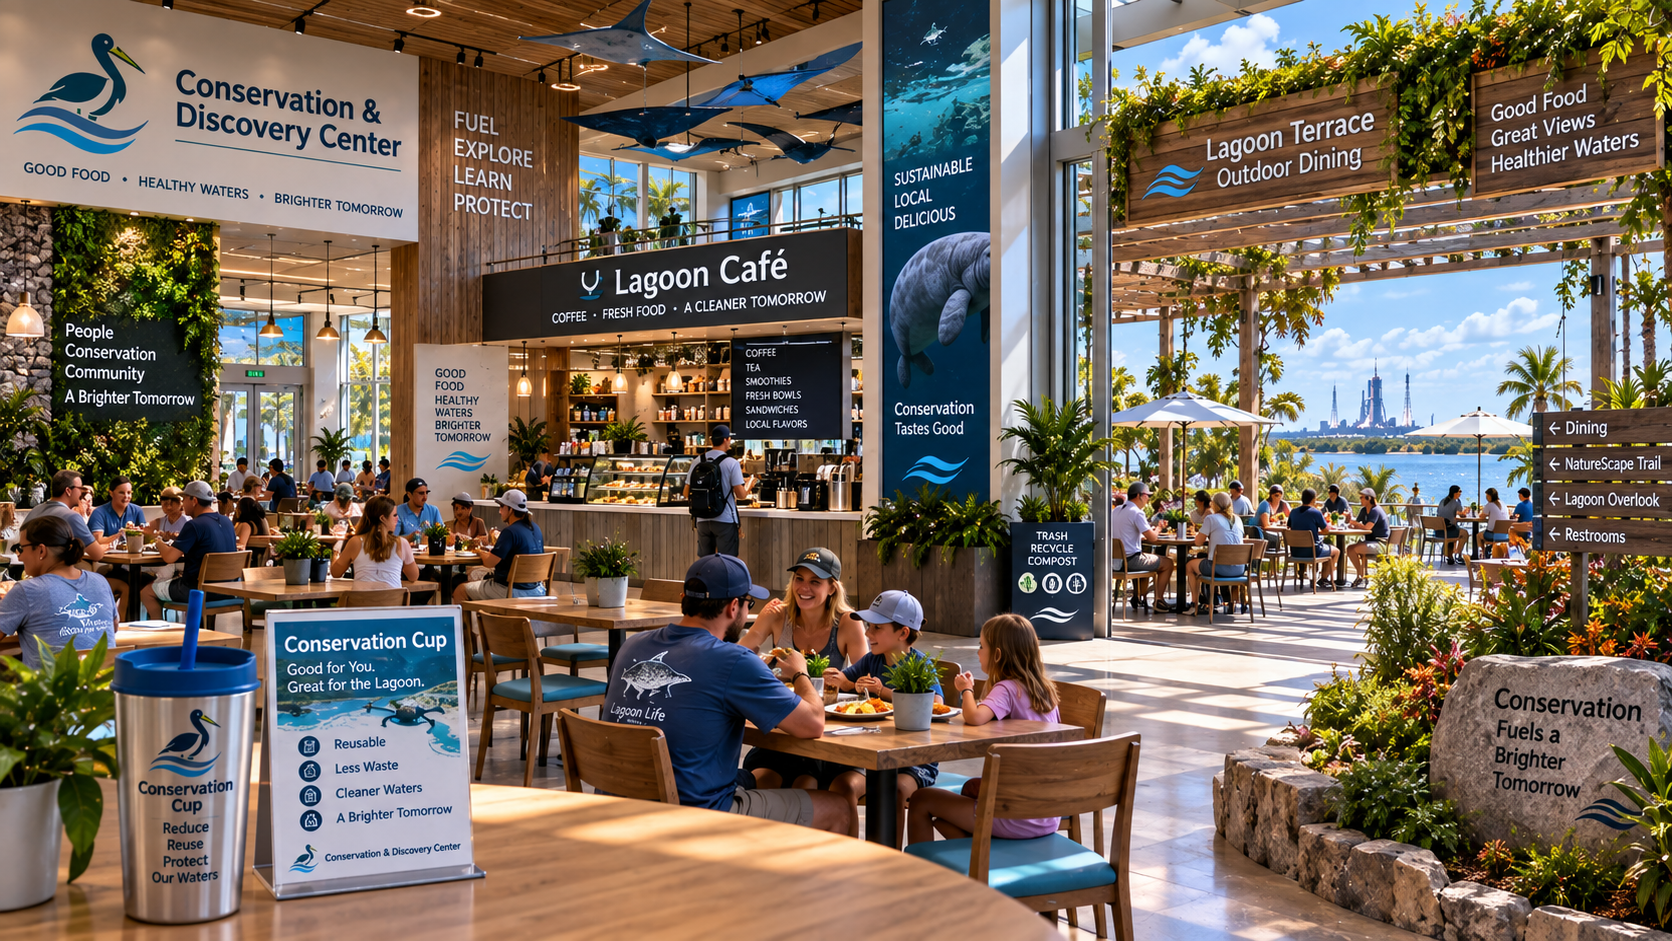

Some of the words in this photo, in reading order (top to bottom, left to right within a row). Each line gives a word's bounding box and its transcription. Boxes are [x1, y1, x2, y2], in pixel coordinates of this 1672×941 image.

[175, 69, 354, 120] Conservation
[362, 98, 381, 124] &
[1490, 94, 1537, 122] Good
[1542, 83, 1587, 111] Food
[176, 101, 311, 150] Discovery
[319, 124, 402, 157] Center
[454, 110, 499, 136] FUEL
[1491, 122, 1538, 147] Great
[1542, 113, 1596, 137] Views
[1207, 130, 1283, 163] Lagoon
[1290, 112, 1375, 144] Terrace
[454, 138, 533, 168] EXPLORE
[1491, 145, 1569, 173] Healthier
[1573, 132, 1639, 157] Waters
[894, 156, 973, 186] SUSTAINABLE
[1217, 160, 1292, 188] Outdoor
[1299, 146, 1362, 171] Dining
[454, 165, 512, 191] LEARN
[23, 161, 67, 178] GOOD
[72, 167, 110, 183] FOOD
[139, 176, 196, 193] HEALTHY
[200, 183, 249, 200] WATERS
[274, 192, 332, 210] BRIGHTER
[335, 200, 403, 218] TOMORROW
[894, 188, 933, 209] LOCAL
[454, 194, 533, 221] PROTECT
[894, 206, 956, 230] DELICIOUS
[615, 264, 709, 300] Lagoon
[720, 248, 788, 285] Café
[552, 310, 587, 325] COFFEE
[602, 306, 632, 320] FRESH
[636, 304, 666, 318] FOOD
[684, 301, 692, 314] A
[694, 297, 747, 312] CLEANER
[750, 290, 827, 308] TOMORROW
[66, 323, 113, 342] People
[65, 343, 156, 361] Conservation
[745, 348, 777, 358] COFFEE
[65, 364, 145, 384] Community
[435, 368, 466, 378] GOOD
[745, 363, 761, 372] TEA
[435, 381, 465, 391] FOOD
[745, 376, 792, 386] SMOOTHIES
[64, 389, 75, 403] A
[78, 389, 130, 408] Brighter
[133, 391, 195, 406] Tomorrow
[435, 395, 479, 405] HEALTHY
[745, 391, 771, 400] FRESH
[773, 390, 802, 400] BOWLS
[435, 408, 473, 417] WATERS
[745, 405, 799, 414] SANDWICHES
[894, 400, 975, 416] Conservation
[435, 420, 481, 430] BRIGHTER
[745, 420, 771, 429] LOCAL
[773, 419, 808, 429] FLAVORS
[894, 421, 930, 435] Tastes
[932, 421, 964, 435] Good
[1565, 420, 1608, 437] Dining
[435, 432, 491, 442] TOMORROW
[1565, 456, 1634, 473] NatureScape
[1637, 455, 1661, 470] Trail
[1565, 492, 1605, 509] Lagoon
[1608, 492, 1660, 507] Overlook
[1036, 531, 1068, 541] TRASH
[1565, 527, 1626, 544] Restrooms
[1030, 544, 1074, 554] RECYCLE
[1028, 556, 1077, 566] COMPOST
[284, 632, 407, 653] Conservation
[412, 631, 447, 651] Cup
[287, 661, 323, 676] Good
[327, 661, 345, 673] for
[348, 660, 375, 673] You.
[287, 680, 324, 693] Great
[327, 679, 346, 692] for
[350, 678, 371, 691] the
[375, 677, 425, 692] Lagoon.
[611, 702, 642, 719] Lagoon
[645, 707, 666, 721] Life
[1494, 688, 1642, 722] Conservation
[1496, 719, 1544, 742] Fuels
[1549, 729, 1560, 744] a
[334, 736, 386, 750] Reusable
[335, 762, 360, 774] Less
[363, 760, 399, 772] Waste
[1495, 746, 1566, 771] Brighter
[138, 779, 234, 796] Conservation
[336, 785, 380, 799] Cleaner
[383, 783, 423, 795] Waters
[1493, 771, 1581, 798] Tomorrow
[171, 799, 202, 815] Cup
[336, 812, 346, 823] A
[349, 808, 394, 824] Brighter
[397, 806, 452, 819] Tomorrow
[162, 821, 209, 834] Reduce
[167, 838, 204, 851] Reuse
[325, 849, 381, 862] Conservation
[383, 847, 390, 857] &
[392, 844, 432, 858] Discovery
[433, 842, 461, 853] Center
[162, 854, 209, 868] Protect
[152, 871, 174, 884] Our
[177, 869, 219, 883] Waters
